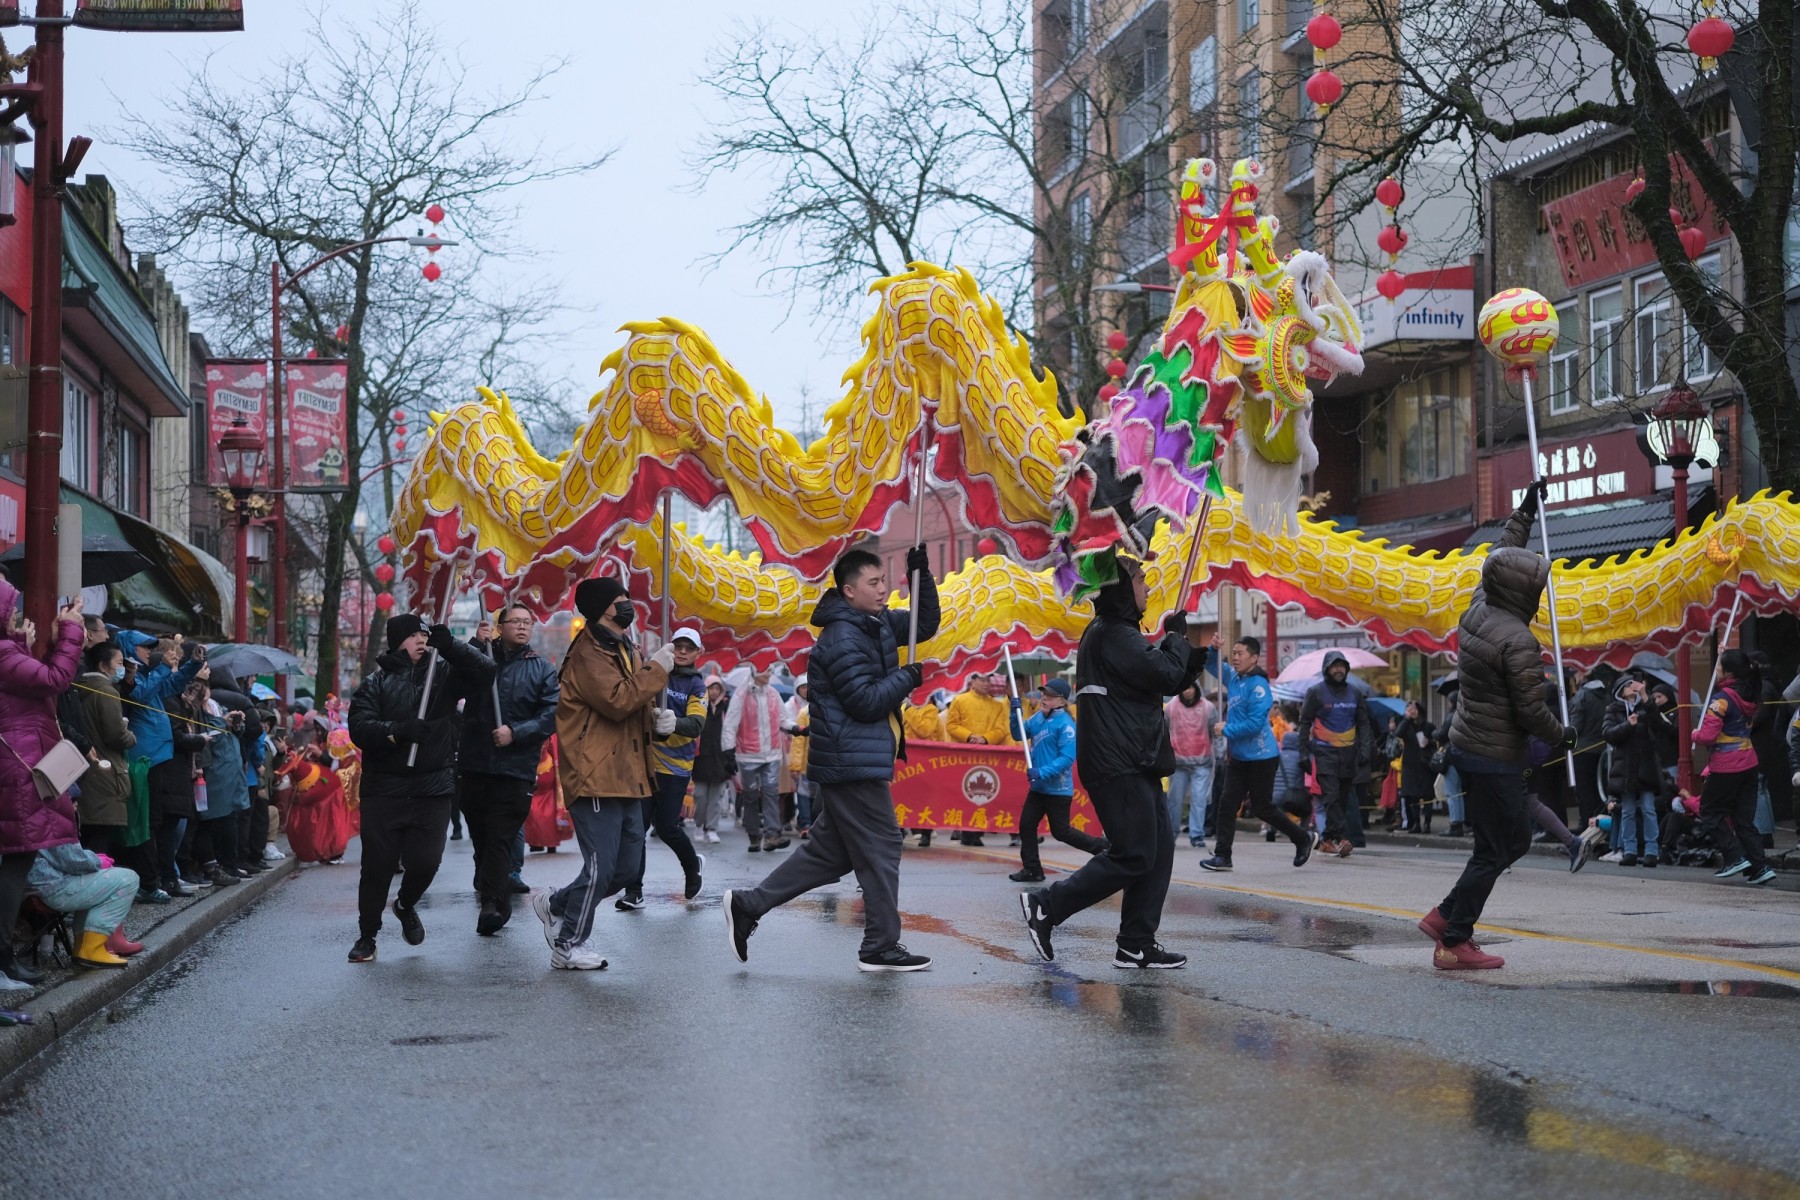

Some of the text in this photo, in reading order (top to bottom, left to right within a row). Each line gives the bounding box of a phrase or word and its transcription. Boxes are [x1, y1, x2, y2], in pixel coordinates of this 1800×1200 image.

[1406, 307, 1464, 329] infinity
[1567, 477, 1594, 500] DIM
[1597, 471, 1625, 495] SUM
[929, 755, 1000, 769] TEOCHEW
